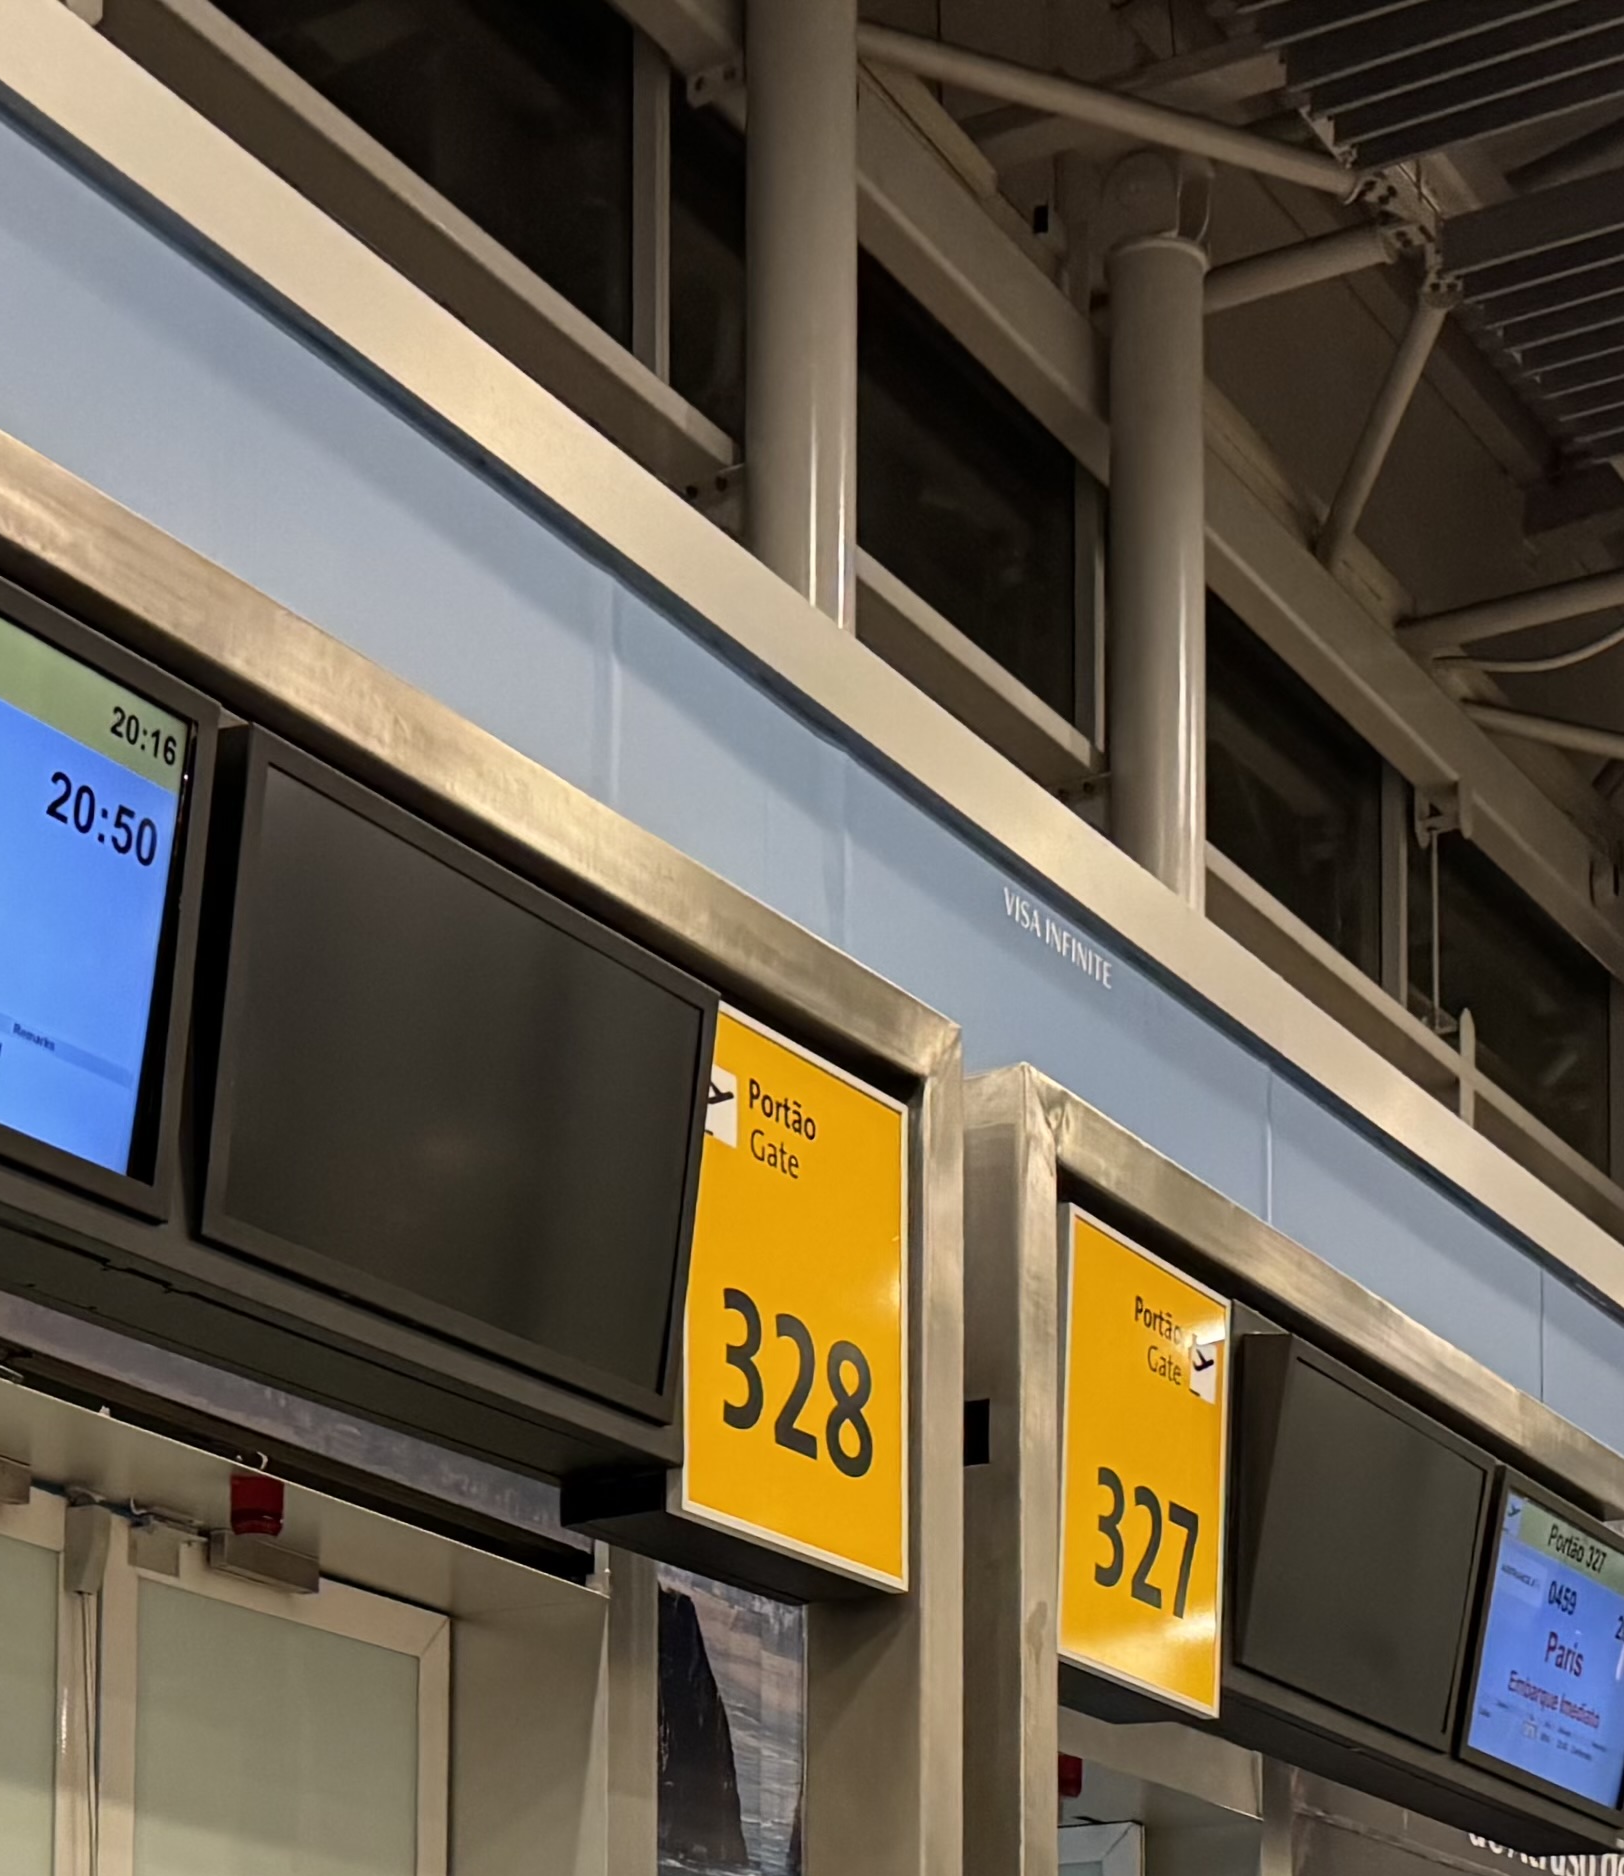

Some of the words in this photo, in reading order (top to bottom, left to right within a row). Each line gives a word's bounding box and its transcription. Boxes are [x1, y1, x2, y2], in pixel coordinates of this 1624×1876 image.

[110, 707, 178, 767] 20:16
[46, 770, 159, 868] 20:50
[1003, 886, 1041, 938] VISA
[1045, 918, 1113, 990] INFINITE
[748, 1078, 817, 1142] Portão
[750, 1128, 800, 1180] Gate
[1134, 1294, 1182, 1345] Portão
[722, 1287, 874, 1478] 328
[1147, 1345, 1181, 1386] Gate
[1092, 1465, 1201, 1618] 327
[1585, 1544, 1607, 1574] 327
[1547, 1580, 1578, 1616] 0459
[1544, 1630, 1585, 1678] Paris
